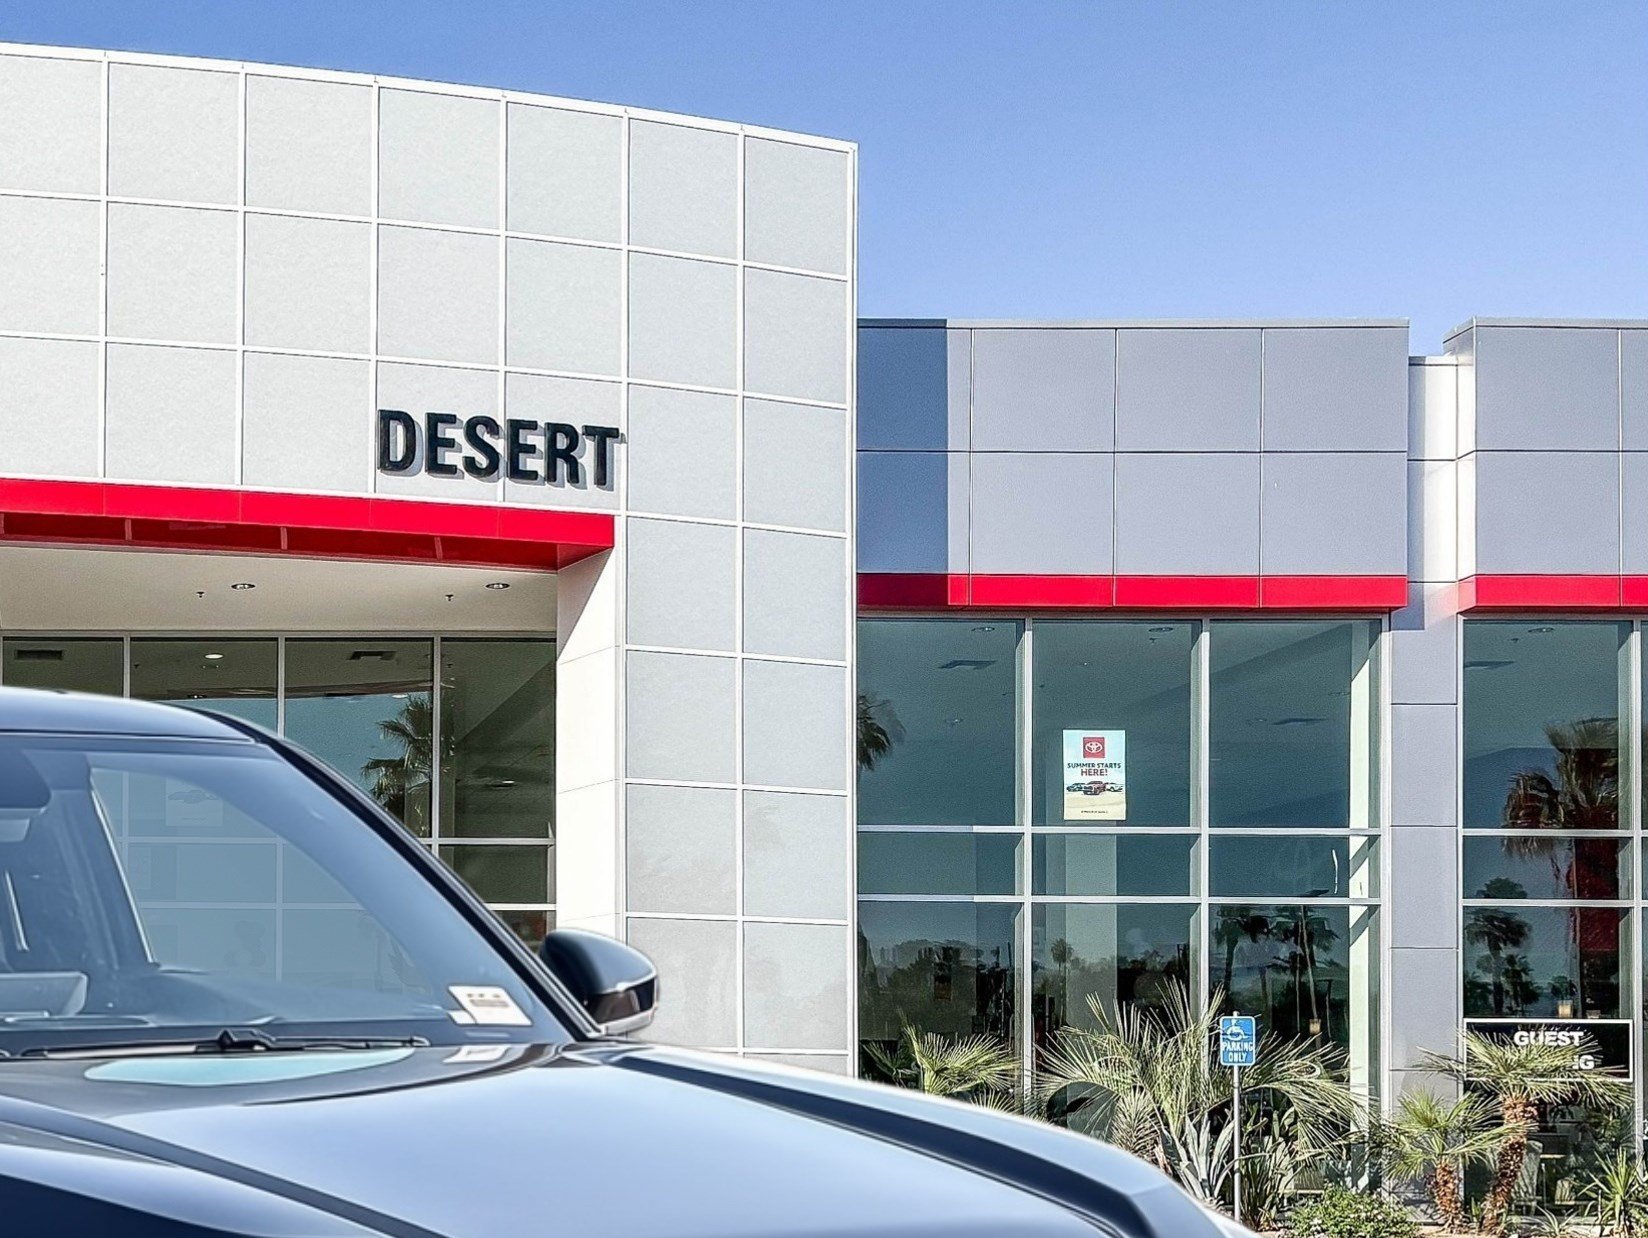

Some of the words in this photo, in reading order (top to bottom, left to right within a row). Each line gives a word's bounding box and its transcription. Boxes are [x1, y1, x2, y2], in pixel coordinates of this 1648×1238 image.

[377, 409, 620, 487] DESERT
[1514, 1031, 1584, 1047] GUEST
[1222, 1041, 1254, 1052] PARKING
[1228, 1052, 1248, 1062] ONLY
